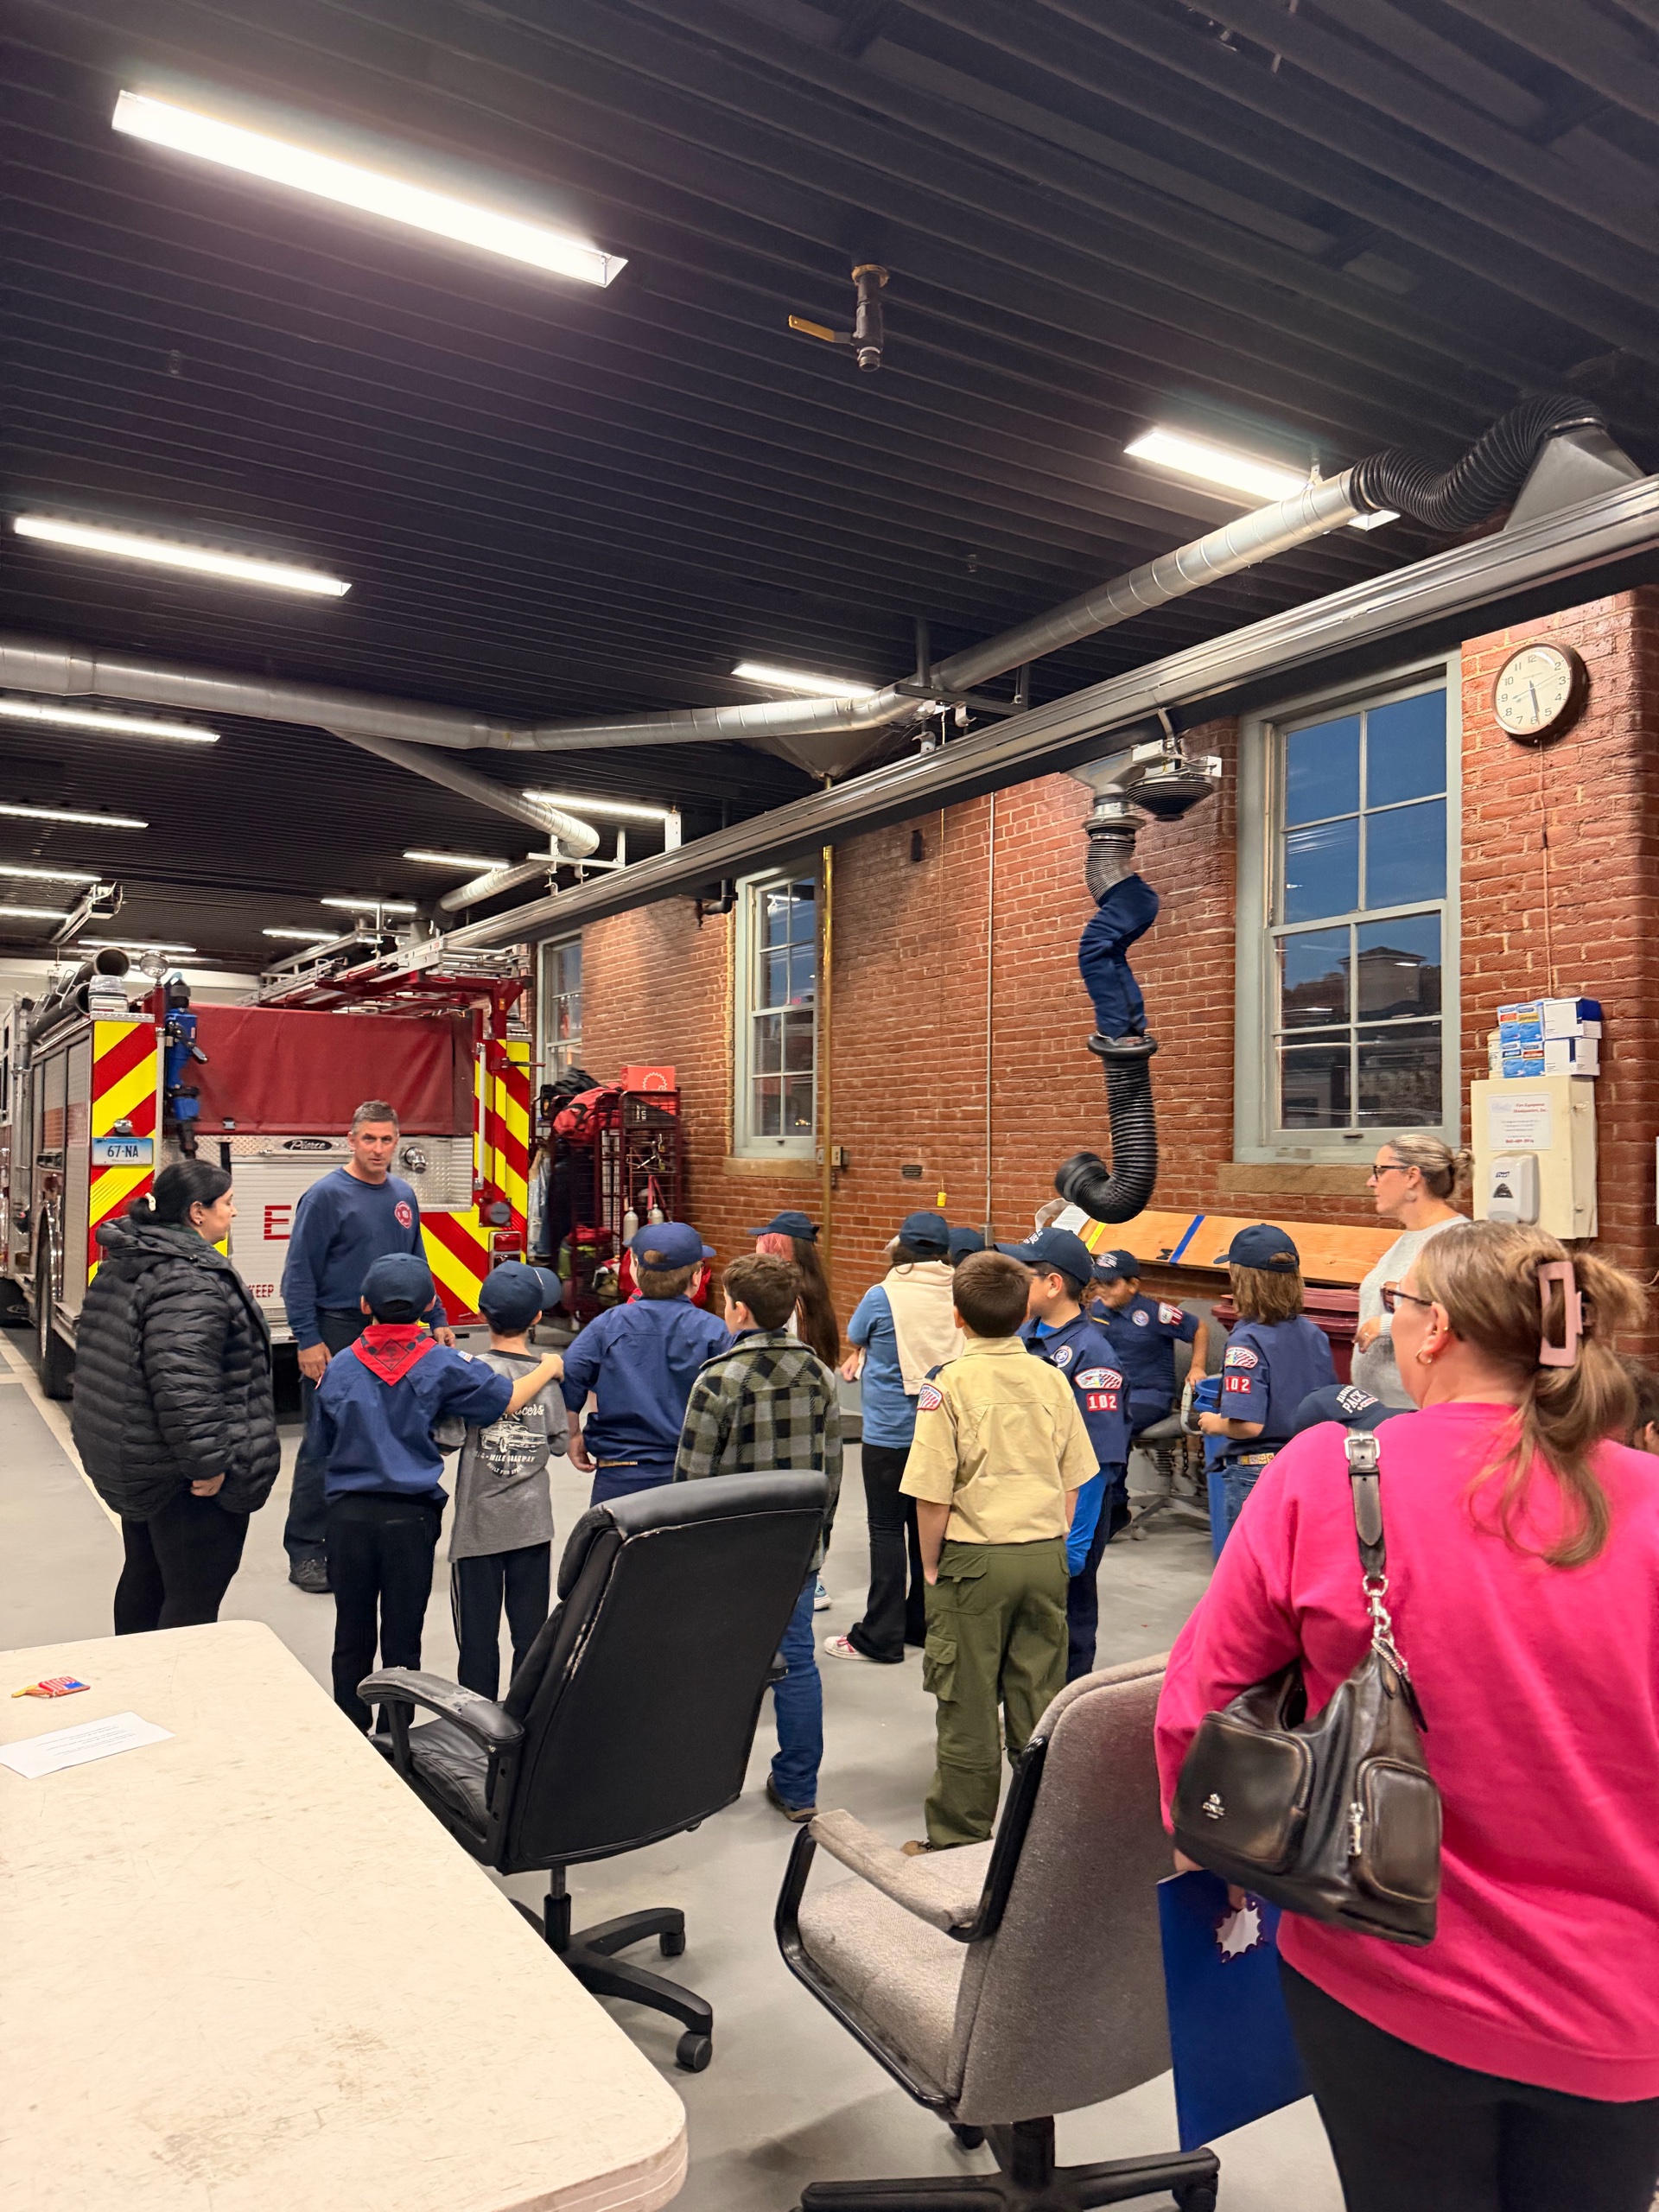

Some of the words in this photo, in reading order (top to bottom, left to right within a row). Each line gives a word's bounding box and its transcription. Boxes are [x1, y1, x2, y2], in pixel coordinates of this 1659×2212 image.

[1527, 654, 1537, 664] 12
[1514, 662, 1522, 671] 11
[1554, 661, 1561, 671] 2
[1504, 676, 1514, 686] 10
[1558, 676, 1567, 685] 3
[1500, 693, 1509, 702] 9
[1554, 693, 1562, 702] 4
[1505, 707, 1512, 716] 8
[1544, 707, 1552, 716] 5
[1516, 715, 1523, 724] 7
[1529, 715, 1538, 725] 6
[106, 1145, 139, 1158] 67-NA
[1225, 1377, 1249, 1391] 102
[1088, 1394, 1117, 1409] 102
[1342, 1389, 1368, 1414] PACK
